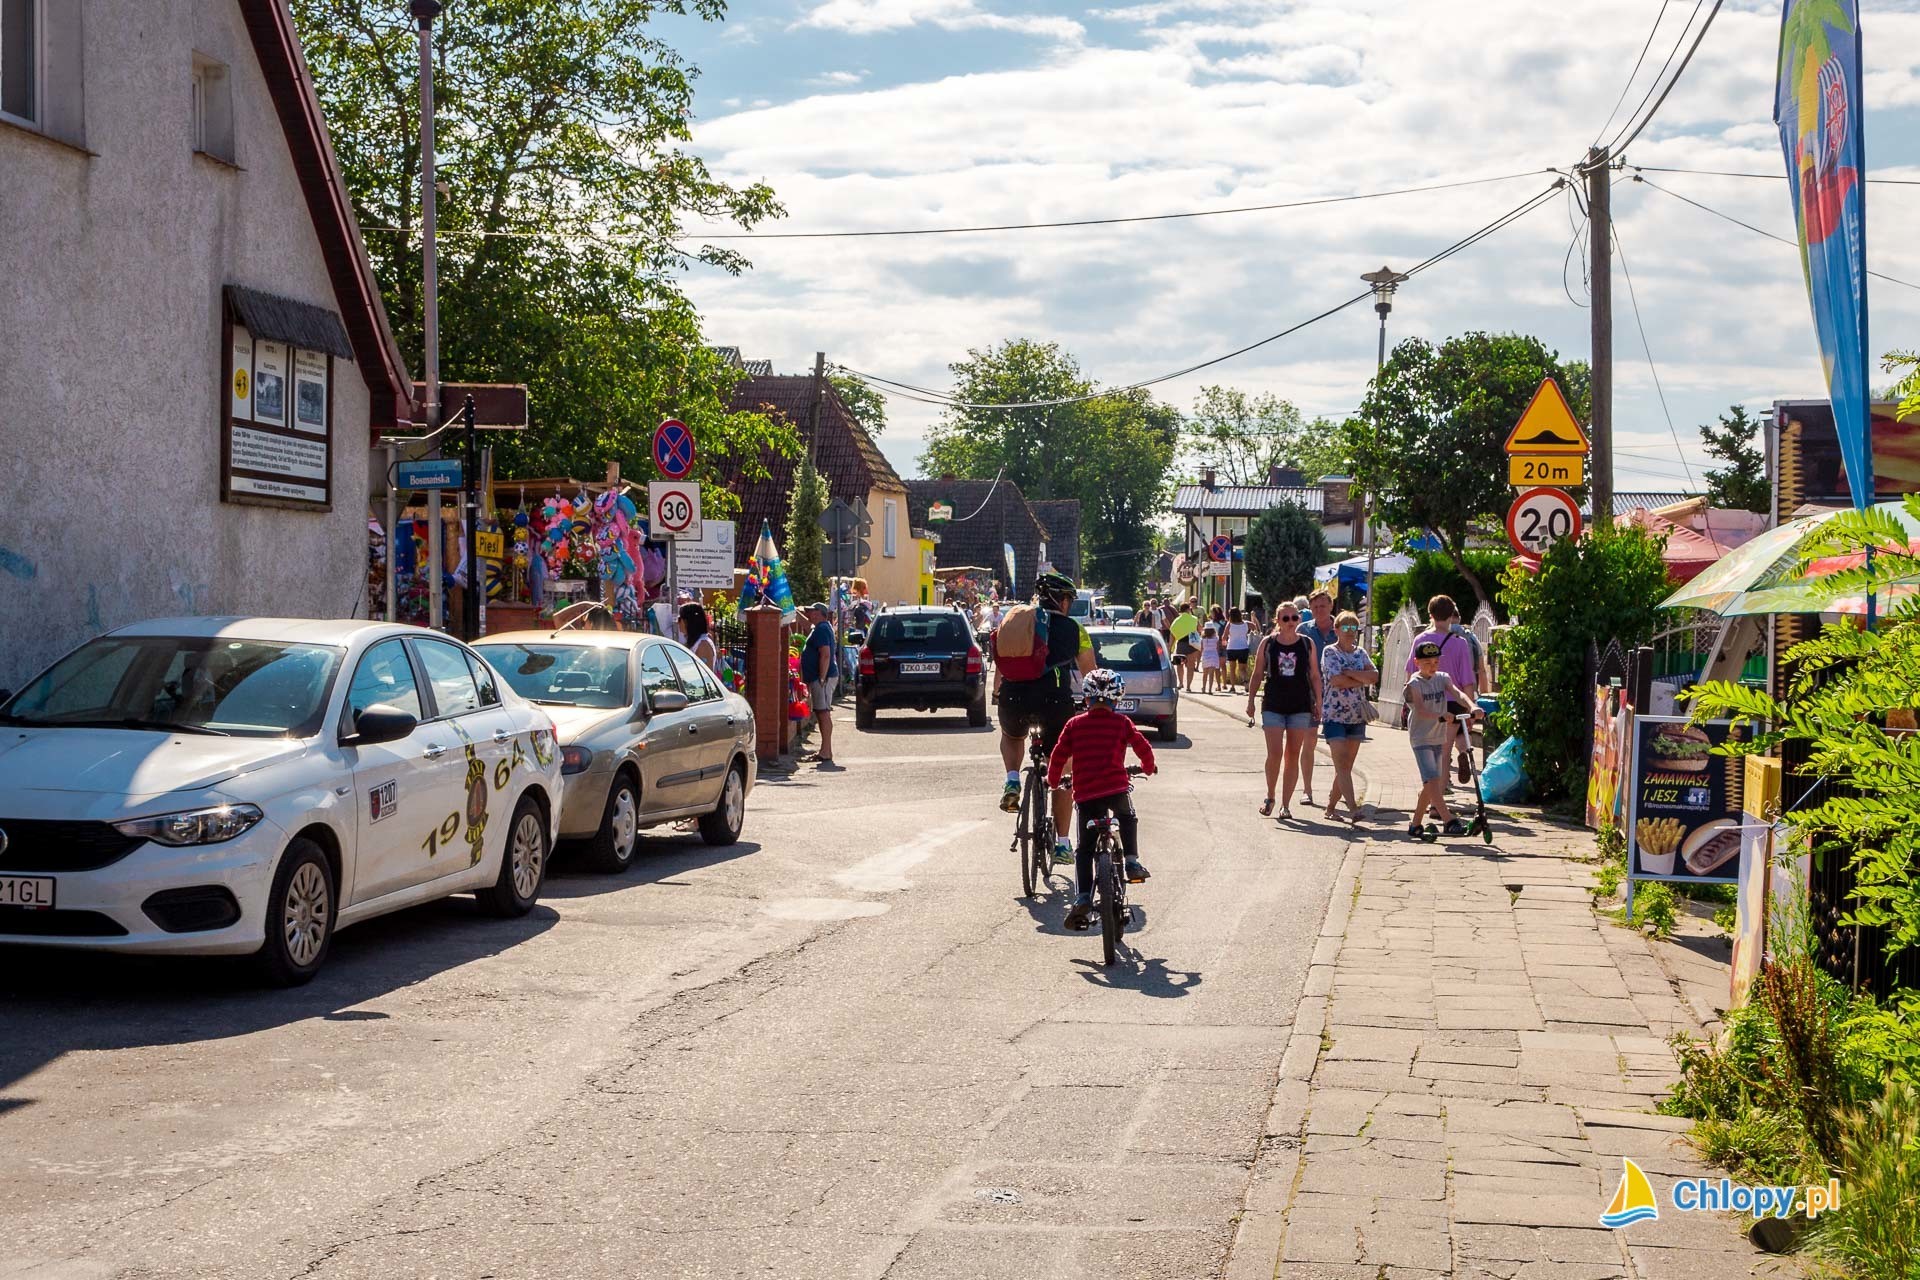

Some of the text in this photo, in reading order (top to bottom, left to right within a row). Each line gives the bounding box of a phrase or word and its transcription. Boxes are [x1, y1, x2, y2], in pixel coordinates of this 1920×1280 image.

[409, 473, 451, 486] Bosmańska
[663, 501, 688, 521] 30
[1520, 507, 1571, 543] 20
[1643, 772, 1711, 787] ZAMAWIASZ
[379, 782, 396, 806] 1207
[1643, 789, 1679, 802] I JESZ
[0, 879, 49, 904] 1GL
